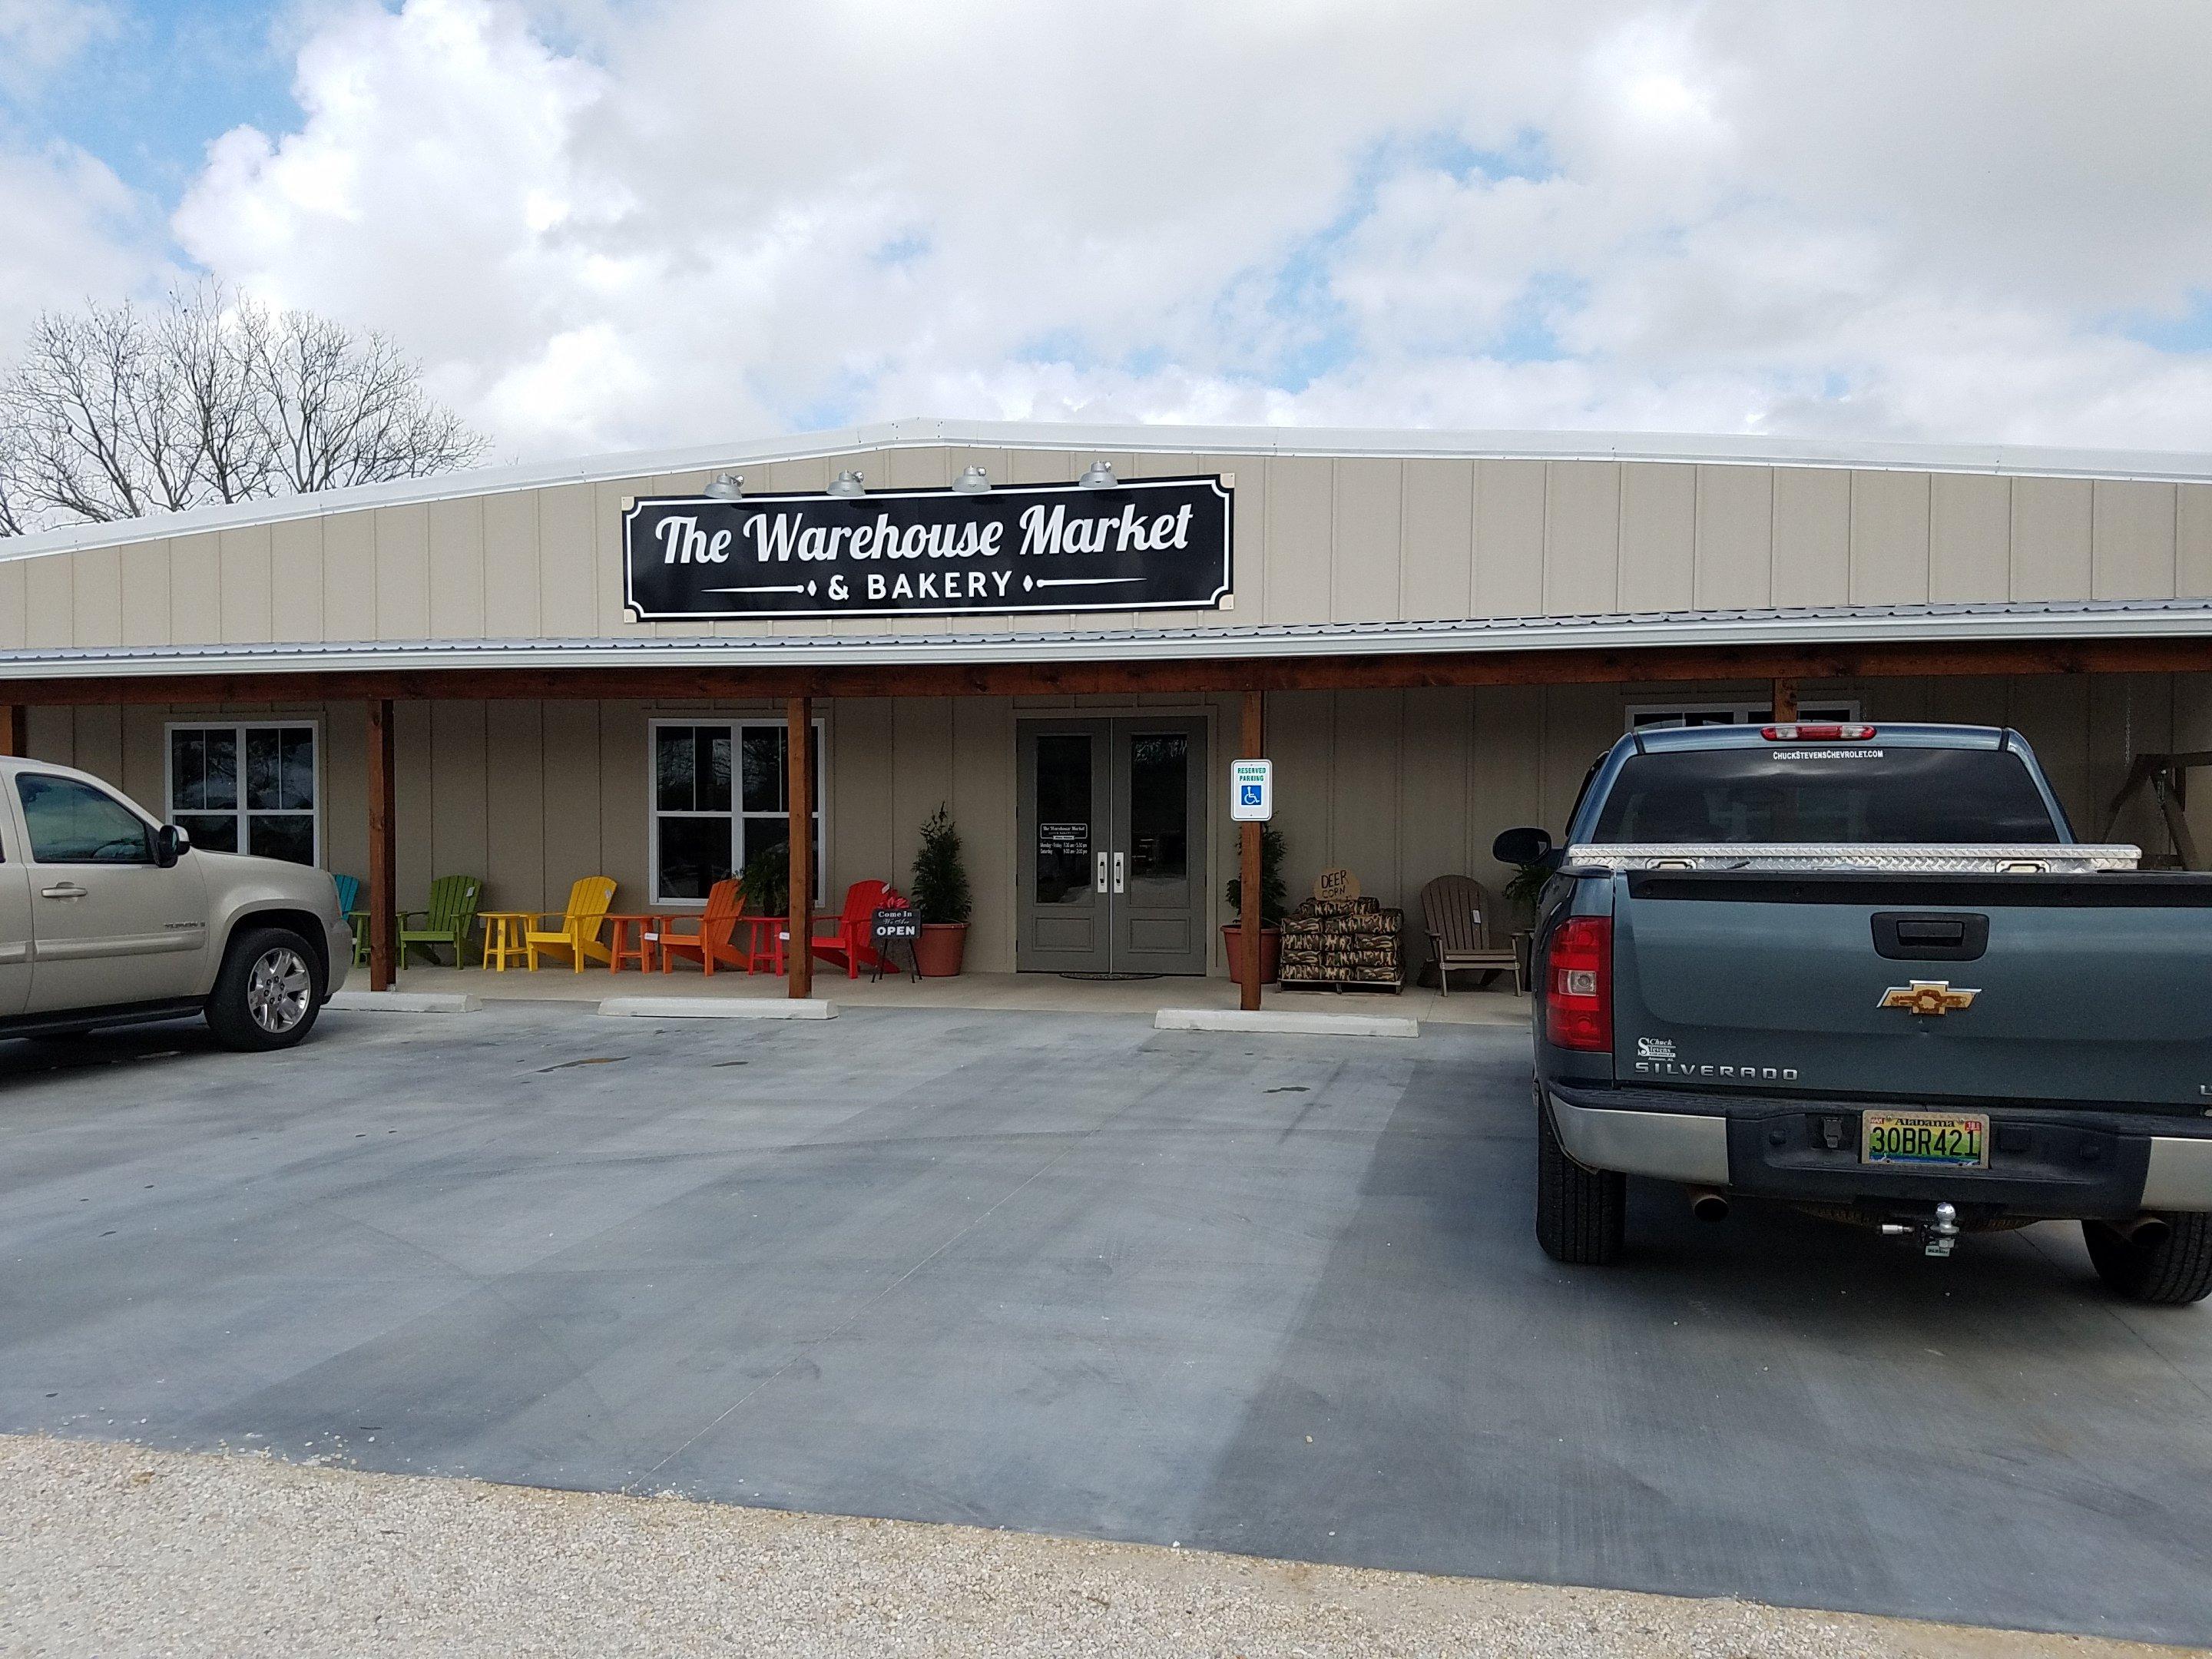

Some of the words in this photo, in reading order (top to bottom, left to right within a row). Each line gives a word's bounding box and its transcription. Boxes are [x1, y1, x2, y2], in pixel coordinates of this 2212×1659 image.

[655, 515, 732, 564] The
[743, 512, 1004, 562] Warehouse
[1018, 504, 1194, 555] Market
[828, 575, 849, 601] &
[867, 570, 1013, 601] BAKERY
[1321, 869, 1349, 889] DEER
[1322, 886, 1346, 899] CORN
[876, 926, 916, 936] OPEN
[1634, 1061, 1798, 1081] SILVERADO
[1895, 1118, 1955, 1128] Alabama
[1872, 1126, 1979, 1157] 30BR421
